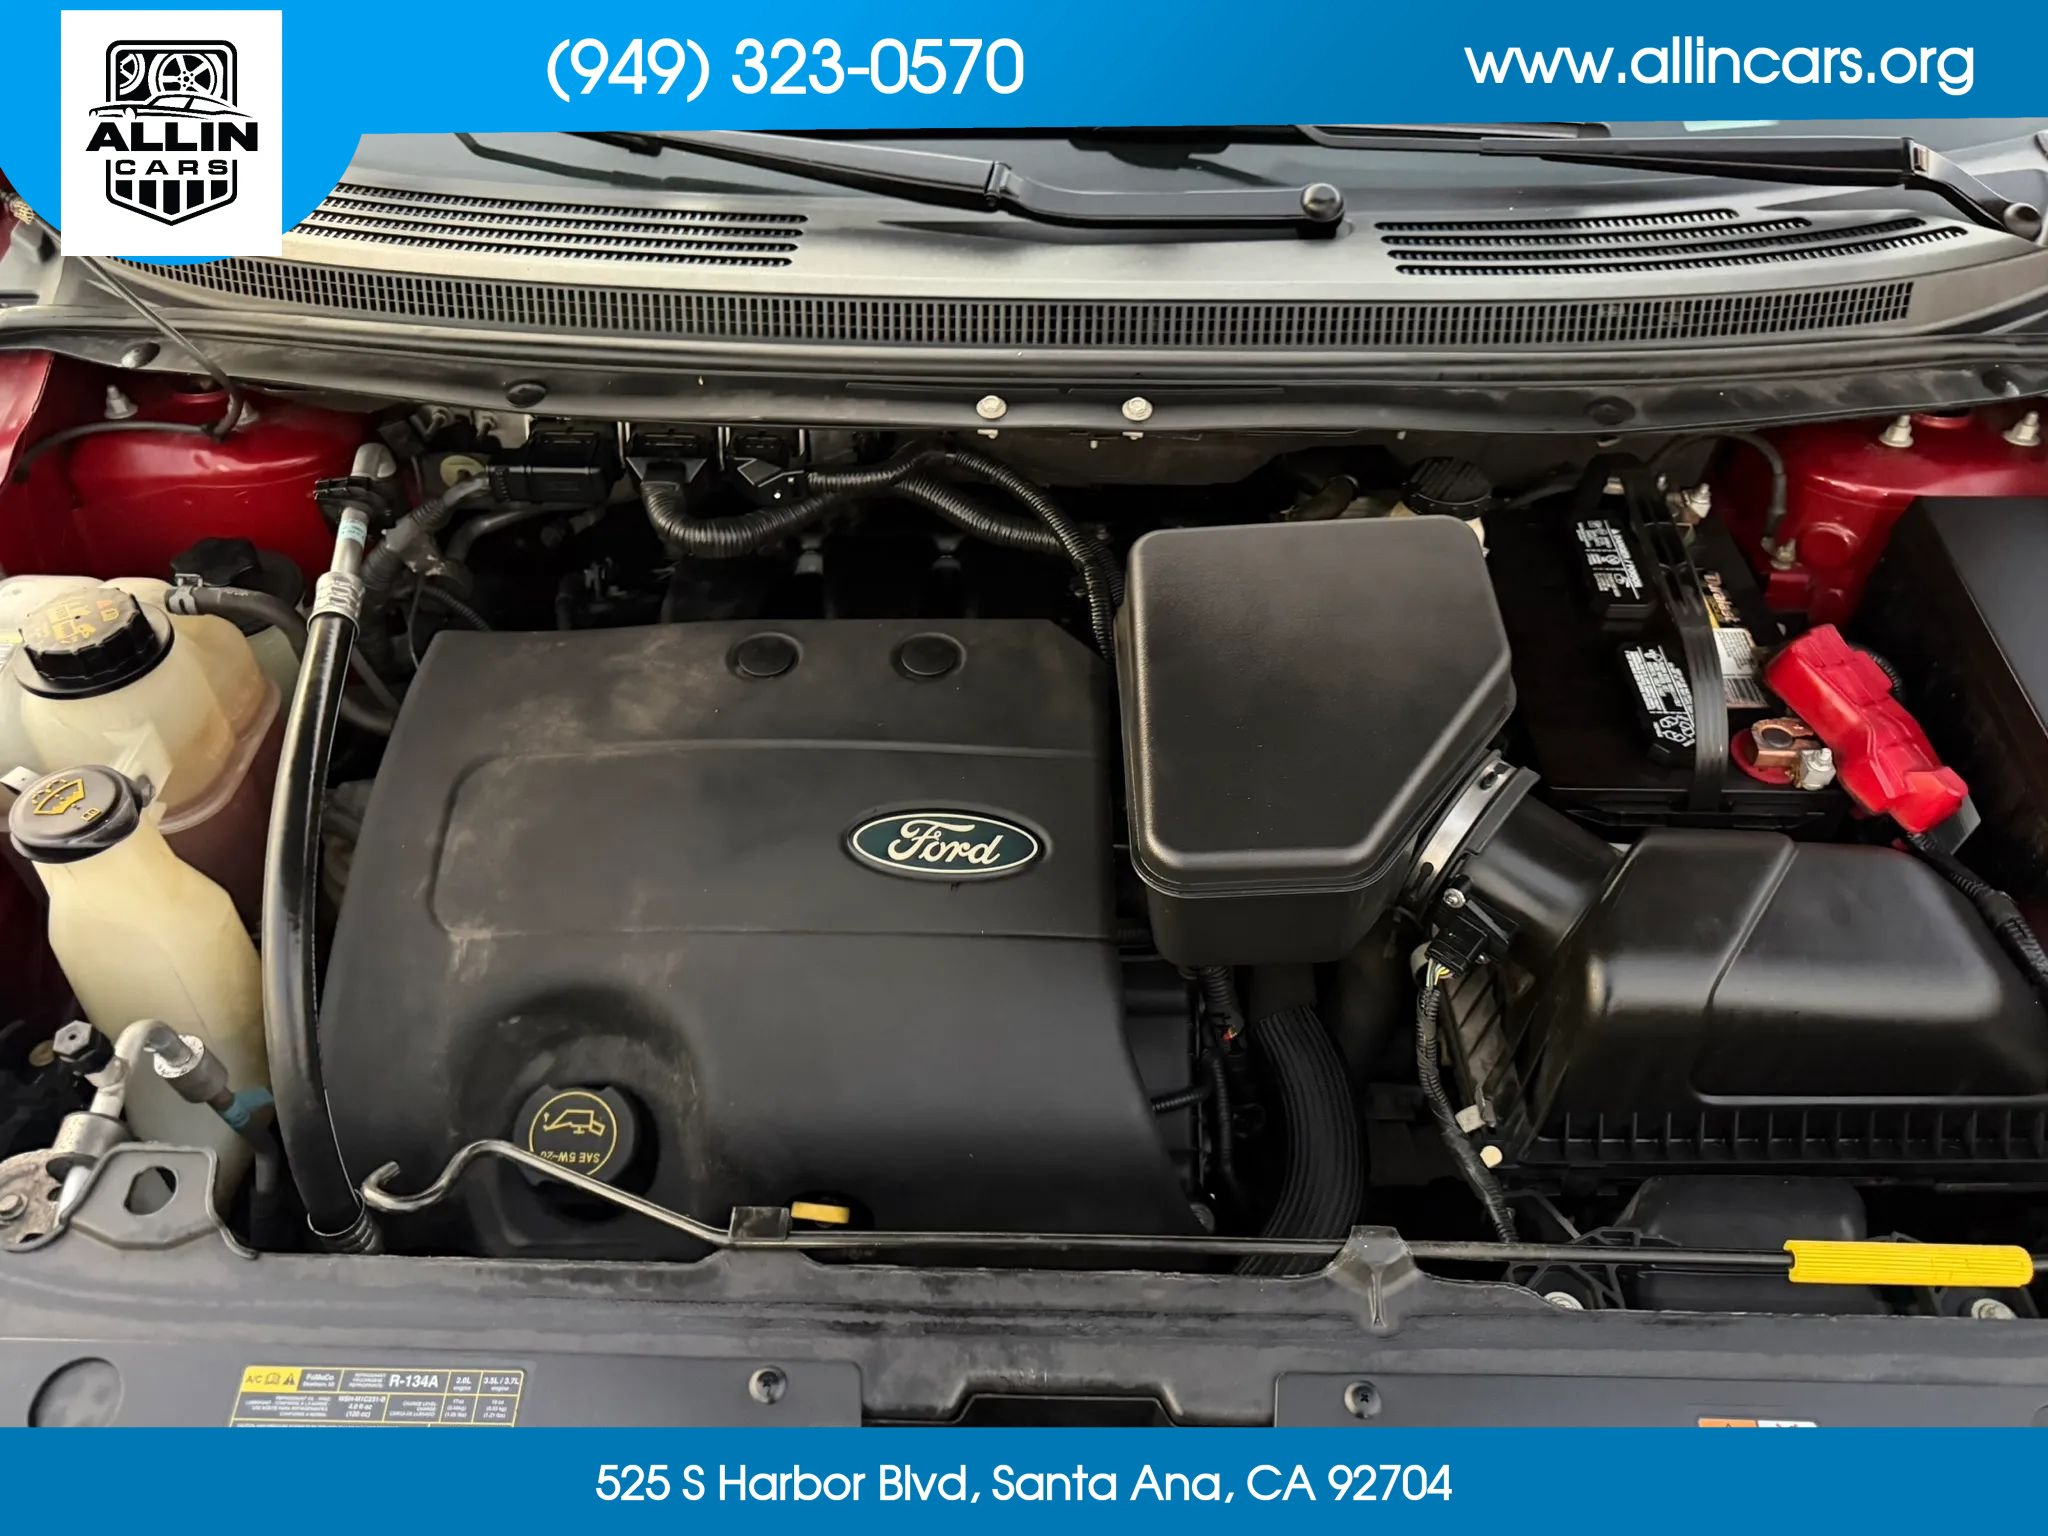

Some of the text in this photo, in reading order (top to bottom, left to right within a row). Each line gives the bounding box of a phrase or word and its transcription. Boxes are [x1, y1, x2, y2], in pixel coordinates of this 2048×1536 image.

[887, 819, 1004, 865] Ford
[579, 1151, 601, 1164] SAE
[388, 1374, 439, 1388] R-134A
